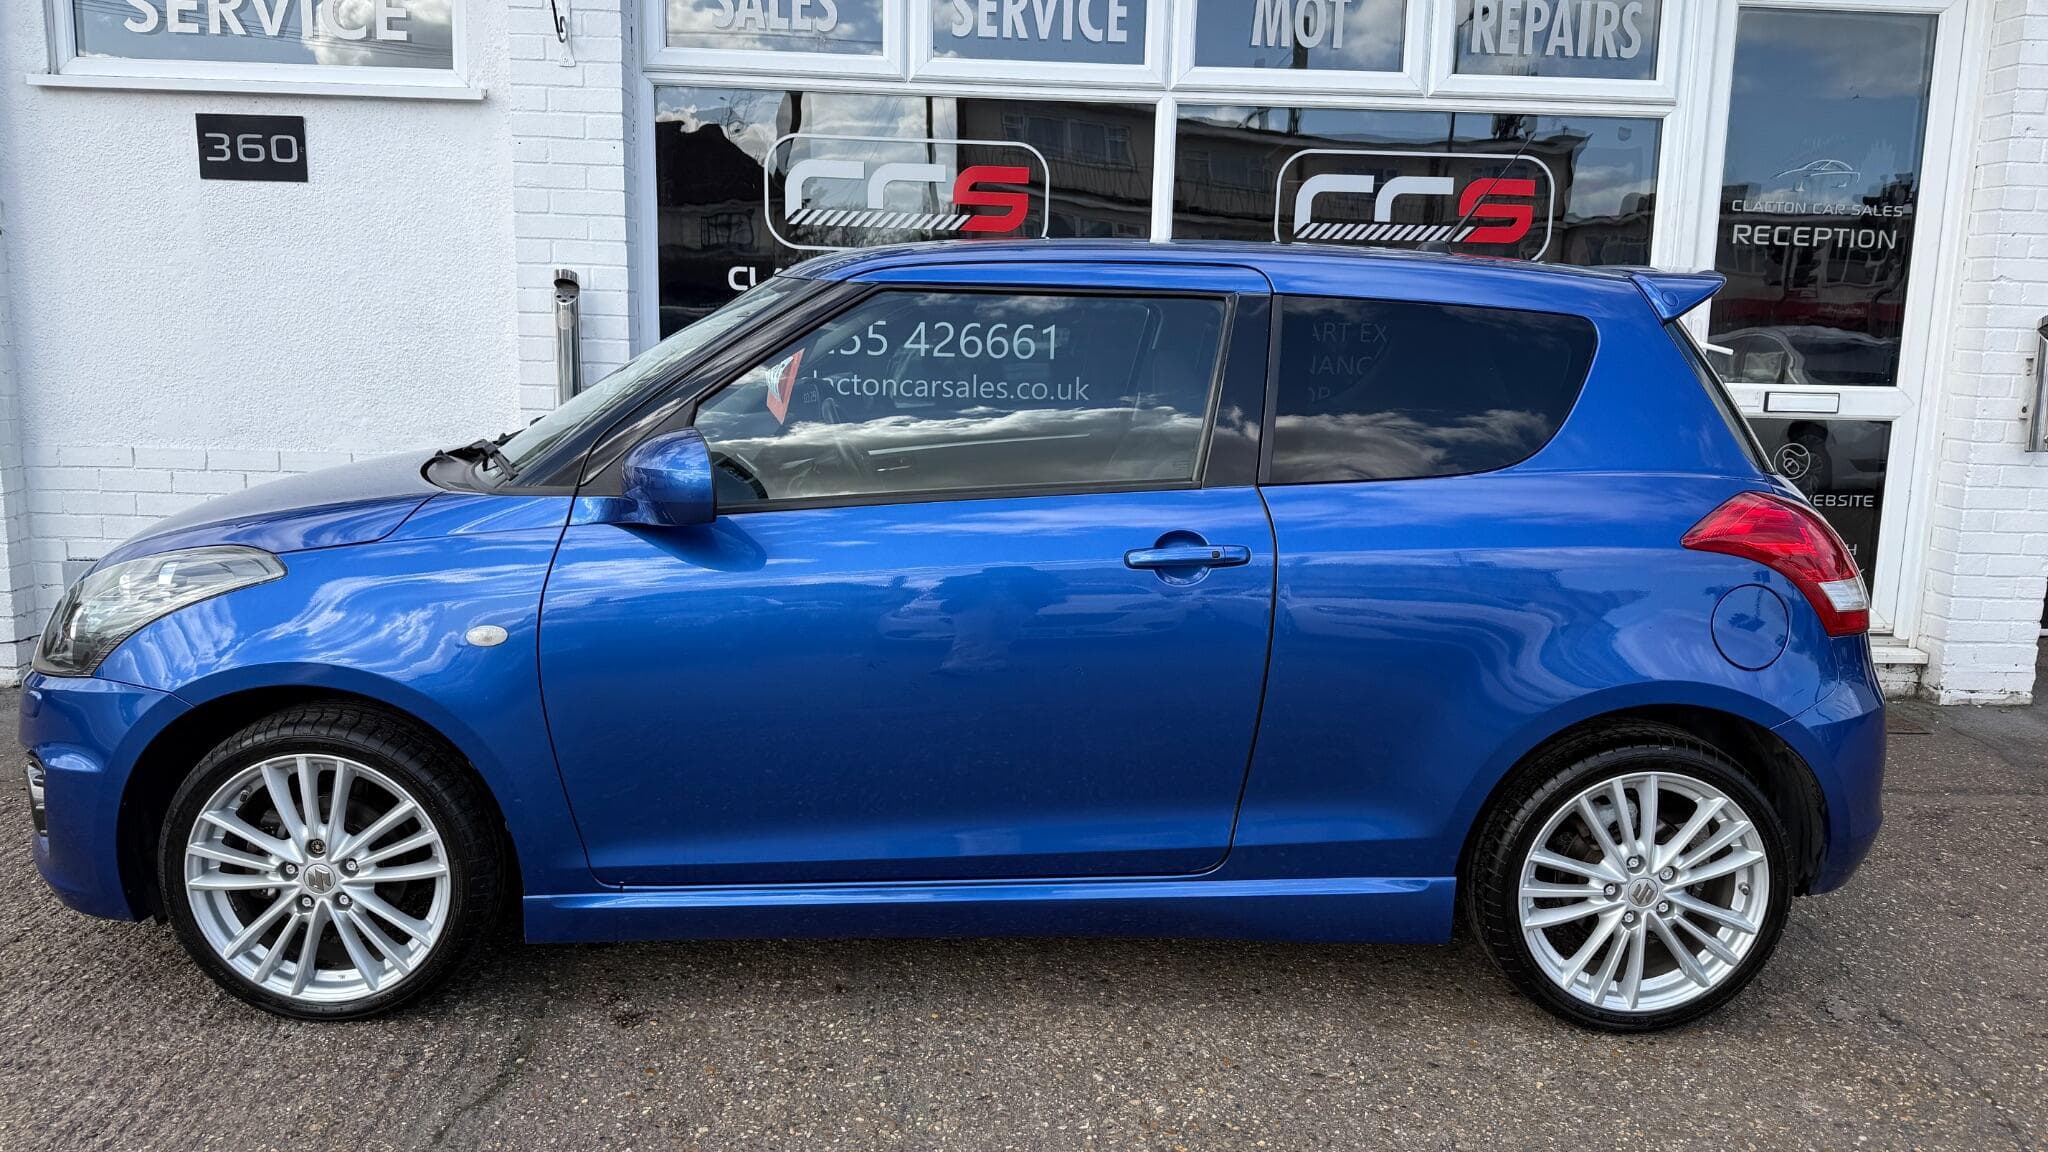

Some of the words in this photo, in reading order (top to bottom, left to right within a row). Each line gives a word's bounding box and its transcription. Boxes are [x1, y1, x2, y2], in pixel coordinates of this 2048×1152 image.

[952, 0, 1128, 42] SERVICE
[1251, 0, 1352, 48] MOT
[1471, 0, 1643, 59] REPAIRS
[204, 132, 298, 163] 360
[1732, 199, 1806, 214] CLACTON
[1812, 202, 1846, 215] CAR
[1851, 204, 1904, 217] SALES
[1732, 224, 1897, 250] RECEPTION
[903, 321, 1056, 360] 426661
[1808, 494, 1874, 507] EBSITE
